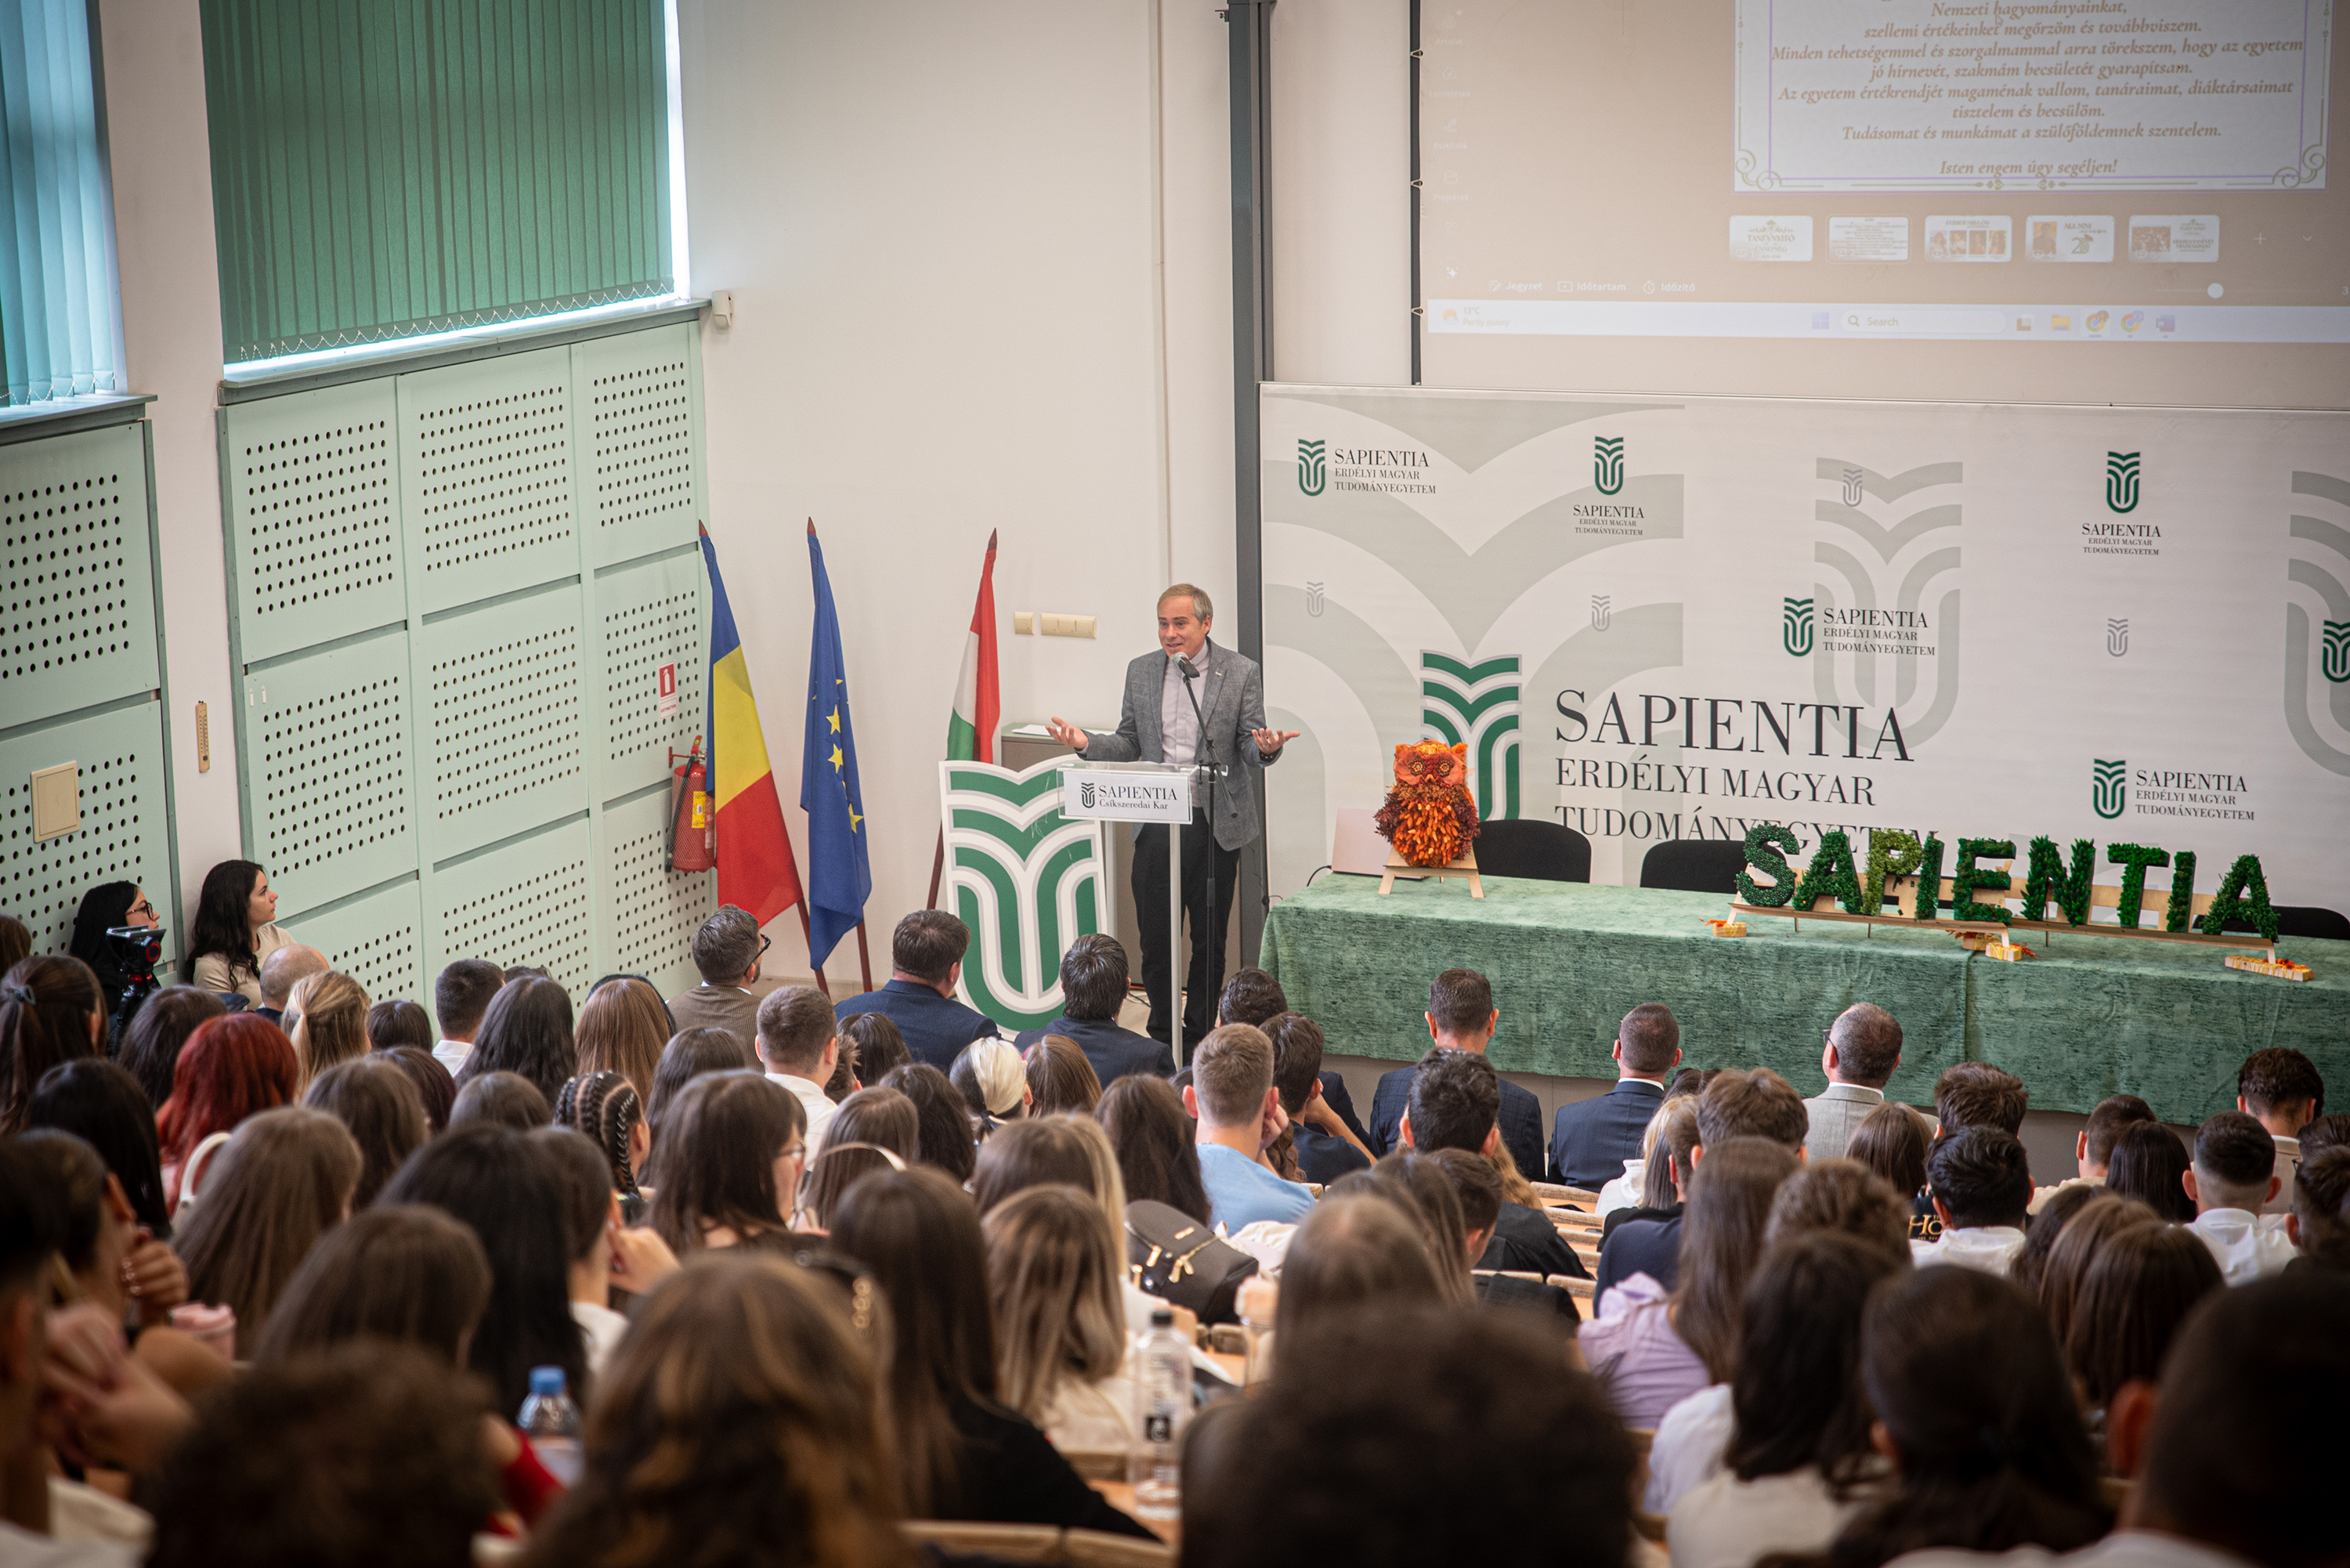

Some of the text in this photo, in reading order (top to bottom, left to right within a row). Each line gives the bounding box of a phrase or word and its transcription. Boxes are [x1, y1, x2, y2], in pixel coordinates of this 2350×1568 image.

[1931, 0, 2127, 20] Nemzeti hagyományainkat,
[1864, 17, 2202, 39] szellemi értékeinket megőrzöm és továbbviszem.
[1771, 38, 2303, 63] Minden tehetségemmel és szorgalmammal arra törekszem, hogy az egyetem
[1869, 60, 2193, 83] jó hírnevét, szakmám becsületét gyarapítsam.
[1778, 78, 2294, 105] Az egyetem értékrendjét magaménak vallom, tanáraimat, diáktársaimat
[1953, 103, 2105, 118] tisztelem és becsülöm.
[1842, 121, 2222, 143] Tudásomat és munkámat a szülőföldemnek szentelem.
[1940, 158, 2118, 178] Isten engem úgy segéljen!
[1506, 281, 1542, 292] Jegyzet
[1577, 281, 1626, 291] Időtartam
[1462, 317, 1509, 328] Partly sunny
[1867, 317, 1899, 326] Search
[1335, 448, 1430, 468] SAPIENTIA
[1335, 466, 1420, 480] ERDÉLYI MAGYAR
[1335, 481, 1436, 494] TUDOMÁNYEGYETEM
[1573, 504, 1644, 518] SAPIENTIA
[1574, 526, 1643, 536] TUDOMÁNYEGYETEM
[2081, 522, 2160, 537] SAPIENTIA
[2083, 546, 2159, 555] TUDOMÁNYEGYETEM
[1824, 608, 1928, 628] SAPIENTIA
[1824, 627, 1918, 641] ERDÉLYI MAGYAR
[1823, 641, 1935, 656] TUDOMÁNYEGYETEM
[1555, 688, 1914, 762] SAPIENTIA
[1555, 753, 1876, 807] ERDÉLYI MAGYAR
[2136, 769, 2248, 793] SAPIENTIA
[1099, 785, 1177, 801] SAPIENTIA
[2135, 789, 2236, 805] ERDÉLYI MAGYAR
[1099, 799, 1169, 810] Csíkszeredai Kar
[2135, 804, 2254, 821] TUDOMÁNYEGYETEM
[1735, 823, 2280, 945] SAPIENTIA
